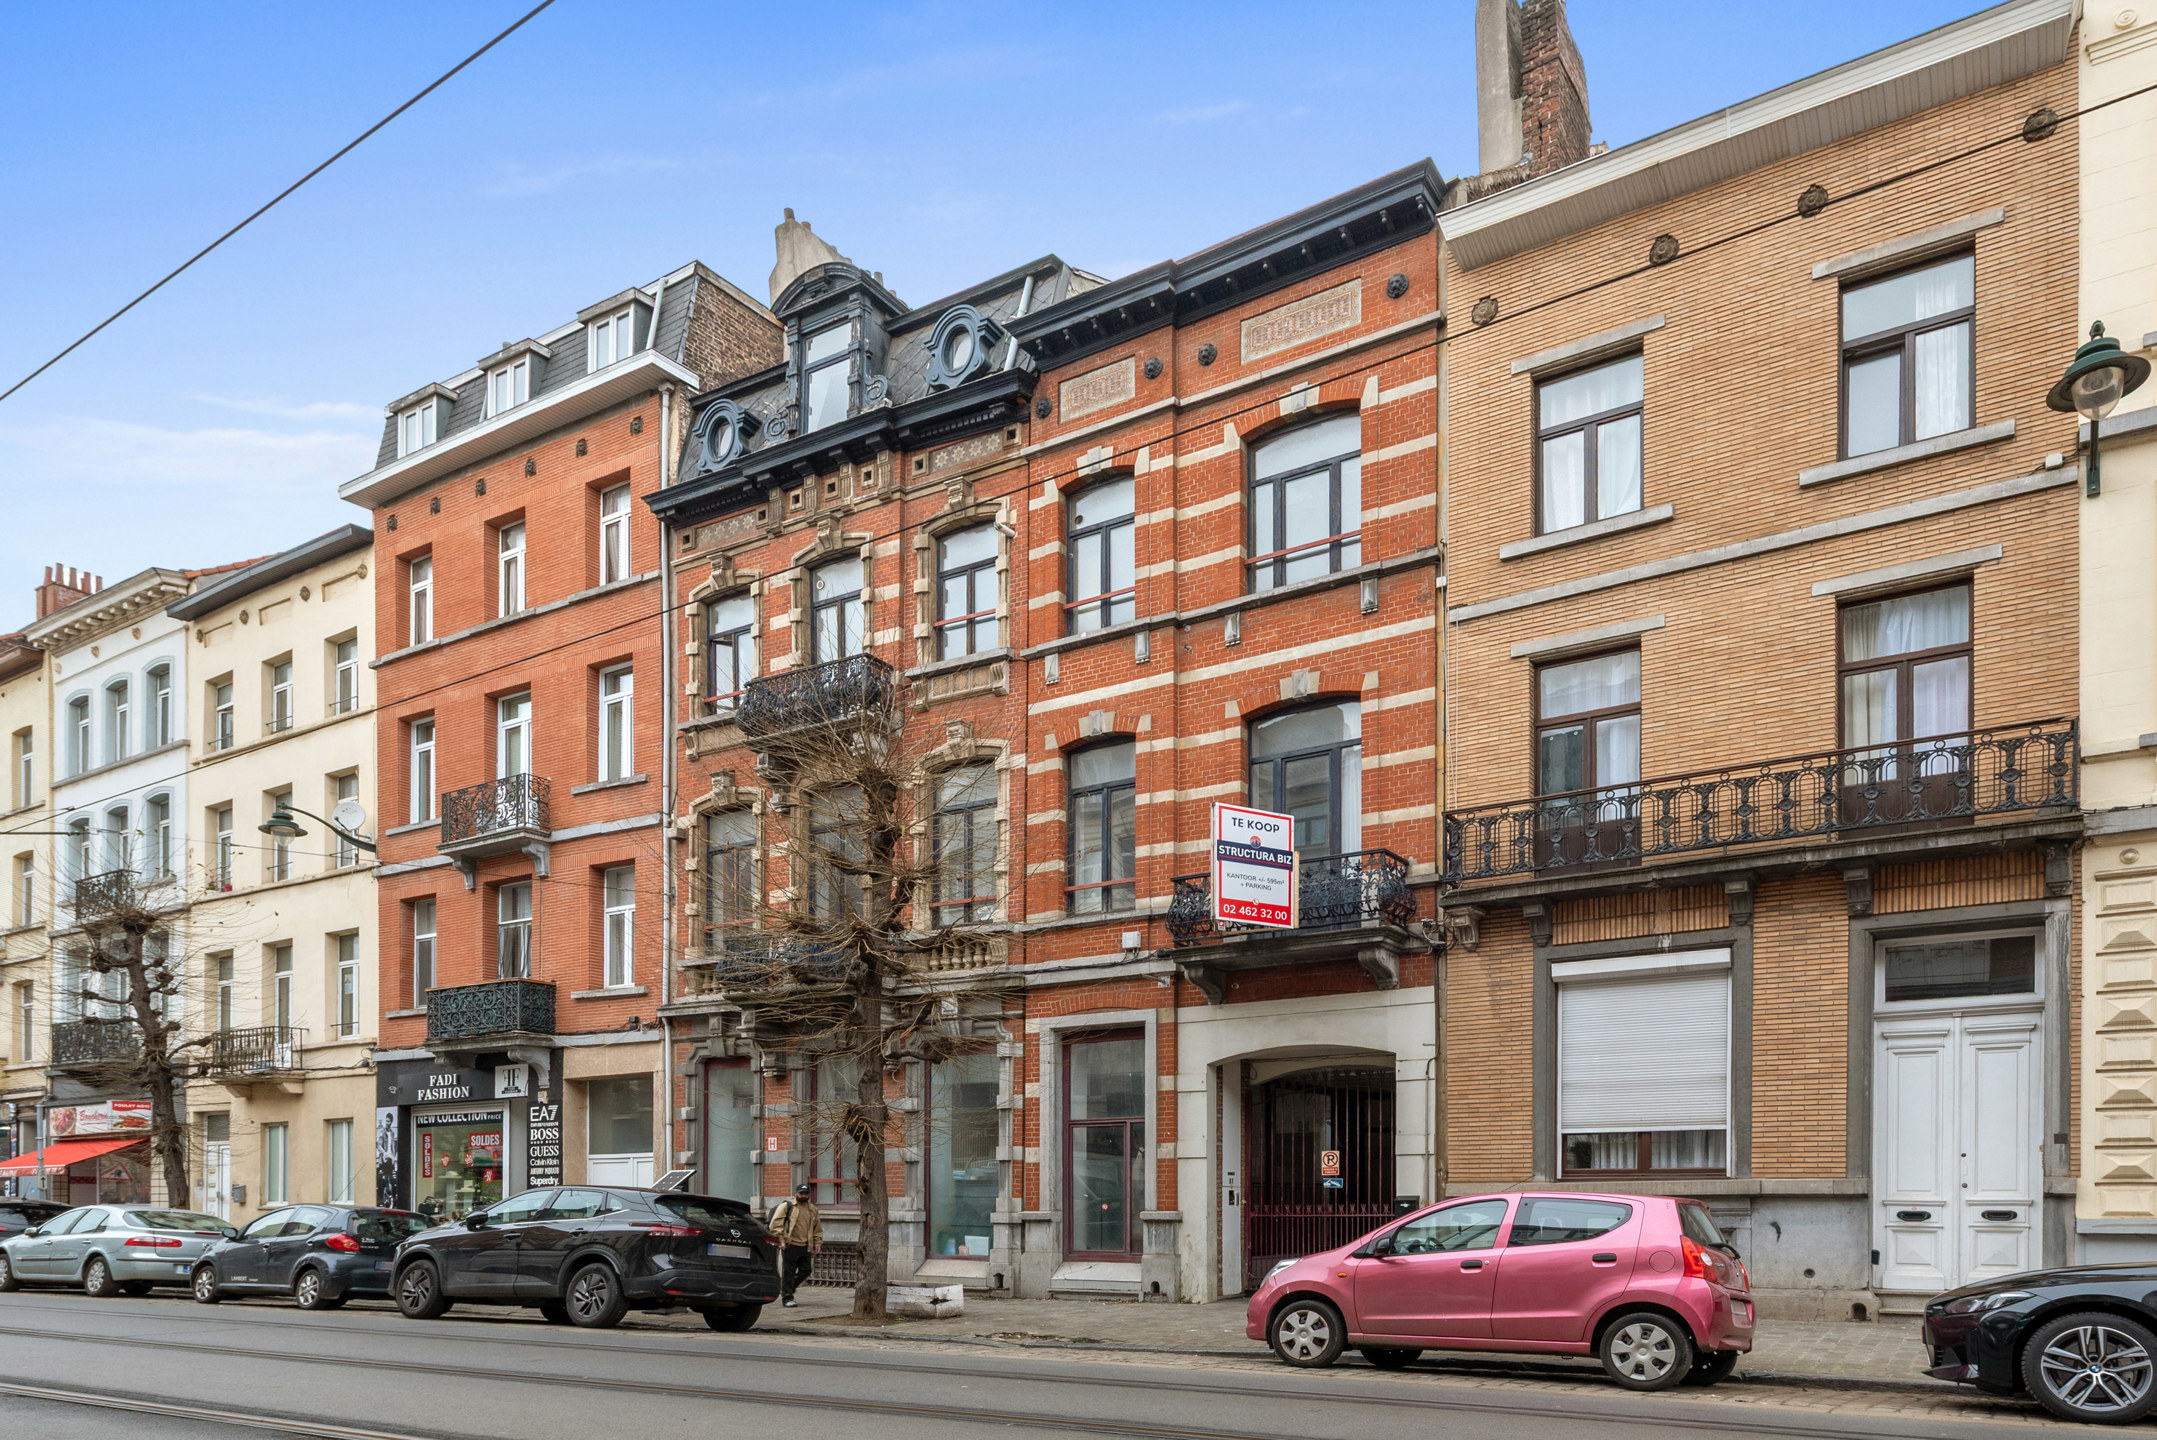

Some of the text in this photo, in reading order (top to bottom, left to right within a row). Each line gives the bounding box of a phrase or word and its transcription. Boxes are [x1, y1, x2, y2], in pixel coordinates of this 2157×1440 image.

[1232, 817, 1280, 833] TE KOOP
[1226, 872, 1257, 881] KANTOOR
[1245, 882, 1272, 891] PARKING
[1223, 904, 1288, 921] 02 462 32 00
[430, 1074, 457, 1087] FADI
[418, 1086, 470, 1101] FASHION
[79, 1109, 108, 1121] Boucheri
[417, 1115, 436, 1124] NEW
[437, 1113, 487, 1123] COLLECTION
[530, 1104, 559, 1122] EA7
[471, 1134, 500, 1146] SOLDES
[530, 1128, 559, 1140] BOSS
[770, 1139, 776, 1149] H
[530, 1145, 560, 1157] GUESS
[530, 1157, 560, 1167] Calvin Klein
